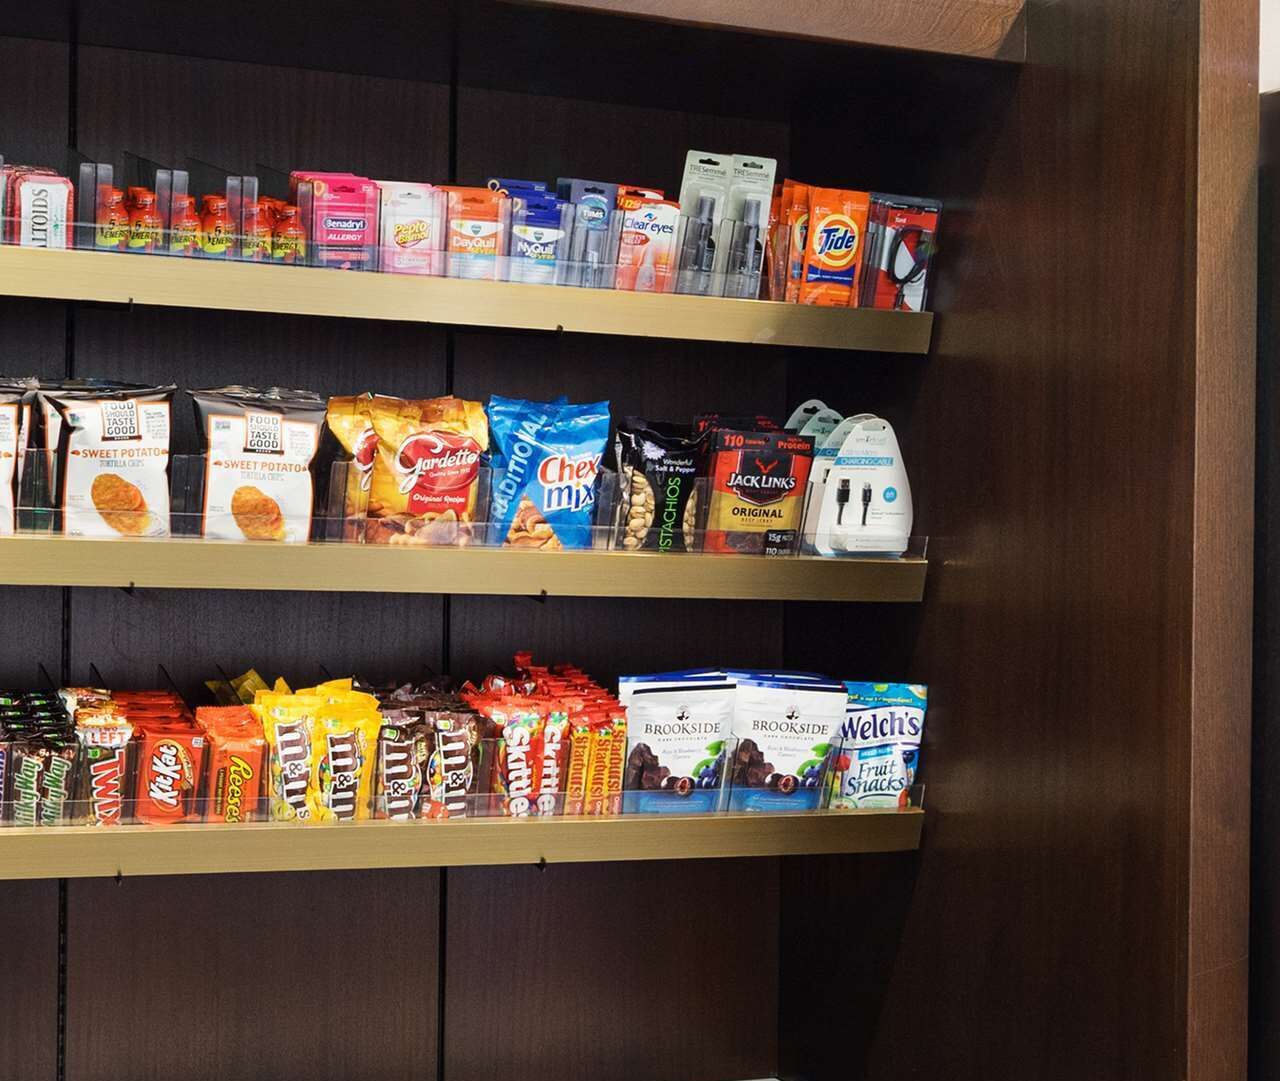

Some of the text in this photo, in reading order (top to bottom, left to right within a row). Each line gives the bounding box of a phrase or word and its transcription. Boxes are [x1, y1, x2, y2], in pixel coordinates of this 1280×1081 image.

[32, 188, 48, 248] LTOIDS
[326, 219, 365, 230] Benadryl
[394, 221, 428, 235] Pepto
[624, 217, 674, 234] Clear eyes
[327, 234, 362, 242] ALLERGY
[453, 236, 496, 248] DayQuil
[818, 226, 856, 255] Tide
[517, 242, 554, 256] NyQuil
[104, 401, 135, 410] FOOD
[106, 417, 135, 426] TASTE
[249, 415, 279, 425] FOOD
[107, 425, 136, 435] GOOD
[250, 432, 278, 440] TASTE
[249, 439, 278, 448] GOOD
[724, 434, 744, 447] 110
[778, 441, 811, 450] Protein
[81, 447, 161, 459] SWEET POTATO
[224, 460, 302, 473] SWEET POTATO
[395, 434, 480, 494] Gardetto
[663, 457, 693, 466] Wonderful
[539, 454, 601, 484] Chex
[655, 465, 668, 473] Salt
[675, 466, 696, 474] Pepper
[727, 473, 760, 488] JACK
[412, 493, 466, 505] Original Recipe
[545, 481, 594, 510] mix
[658, 477, 681, 552] ISTACHIOS
[732, 507, 784, 519] ORIGINAL
[644, 722, 721, 736] BROOKSIDE
[752, 720, 829, 736] BROOKSIDE
[841, 711, 920, 740] Welch's
[91, 732, 128, 745] LEFT
[858, 759, 897, 780] Fruit
[845, 774, 905, 796] Snacks
